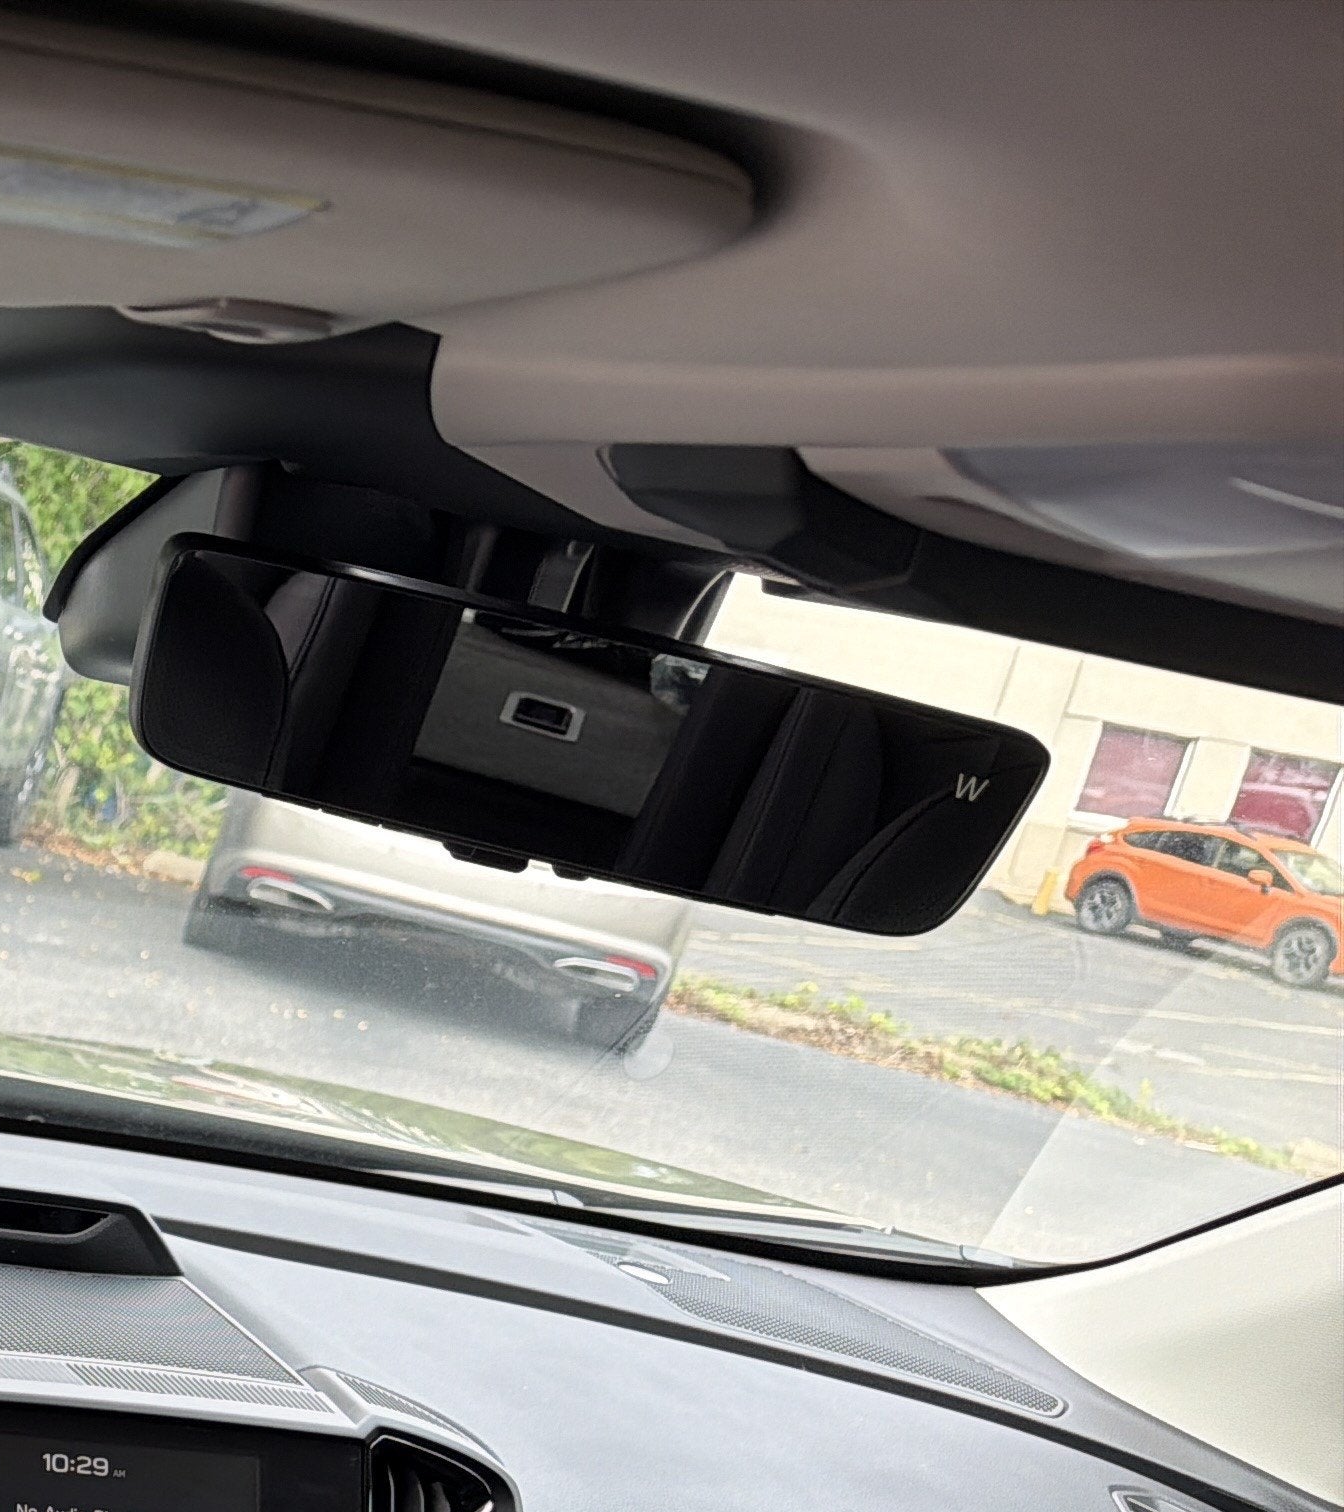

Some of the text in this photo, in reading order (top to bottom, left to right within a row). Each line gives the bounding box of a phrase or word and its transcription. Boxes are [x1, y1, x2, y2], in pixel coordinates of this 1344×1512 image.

[955, 772, 990, 802] W
[42, 1452, 126, 1478] 10:29 AM
